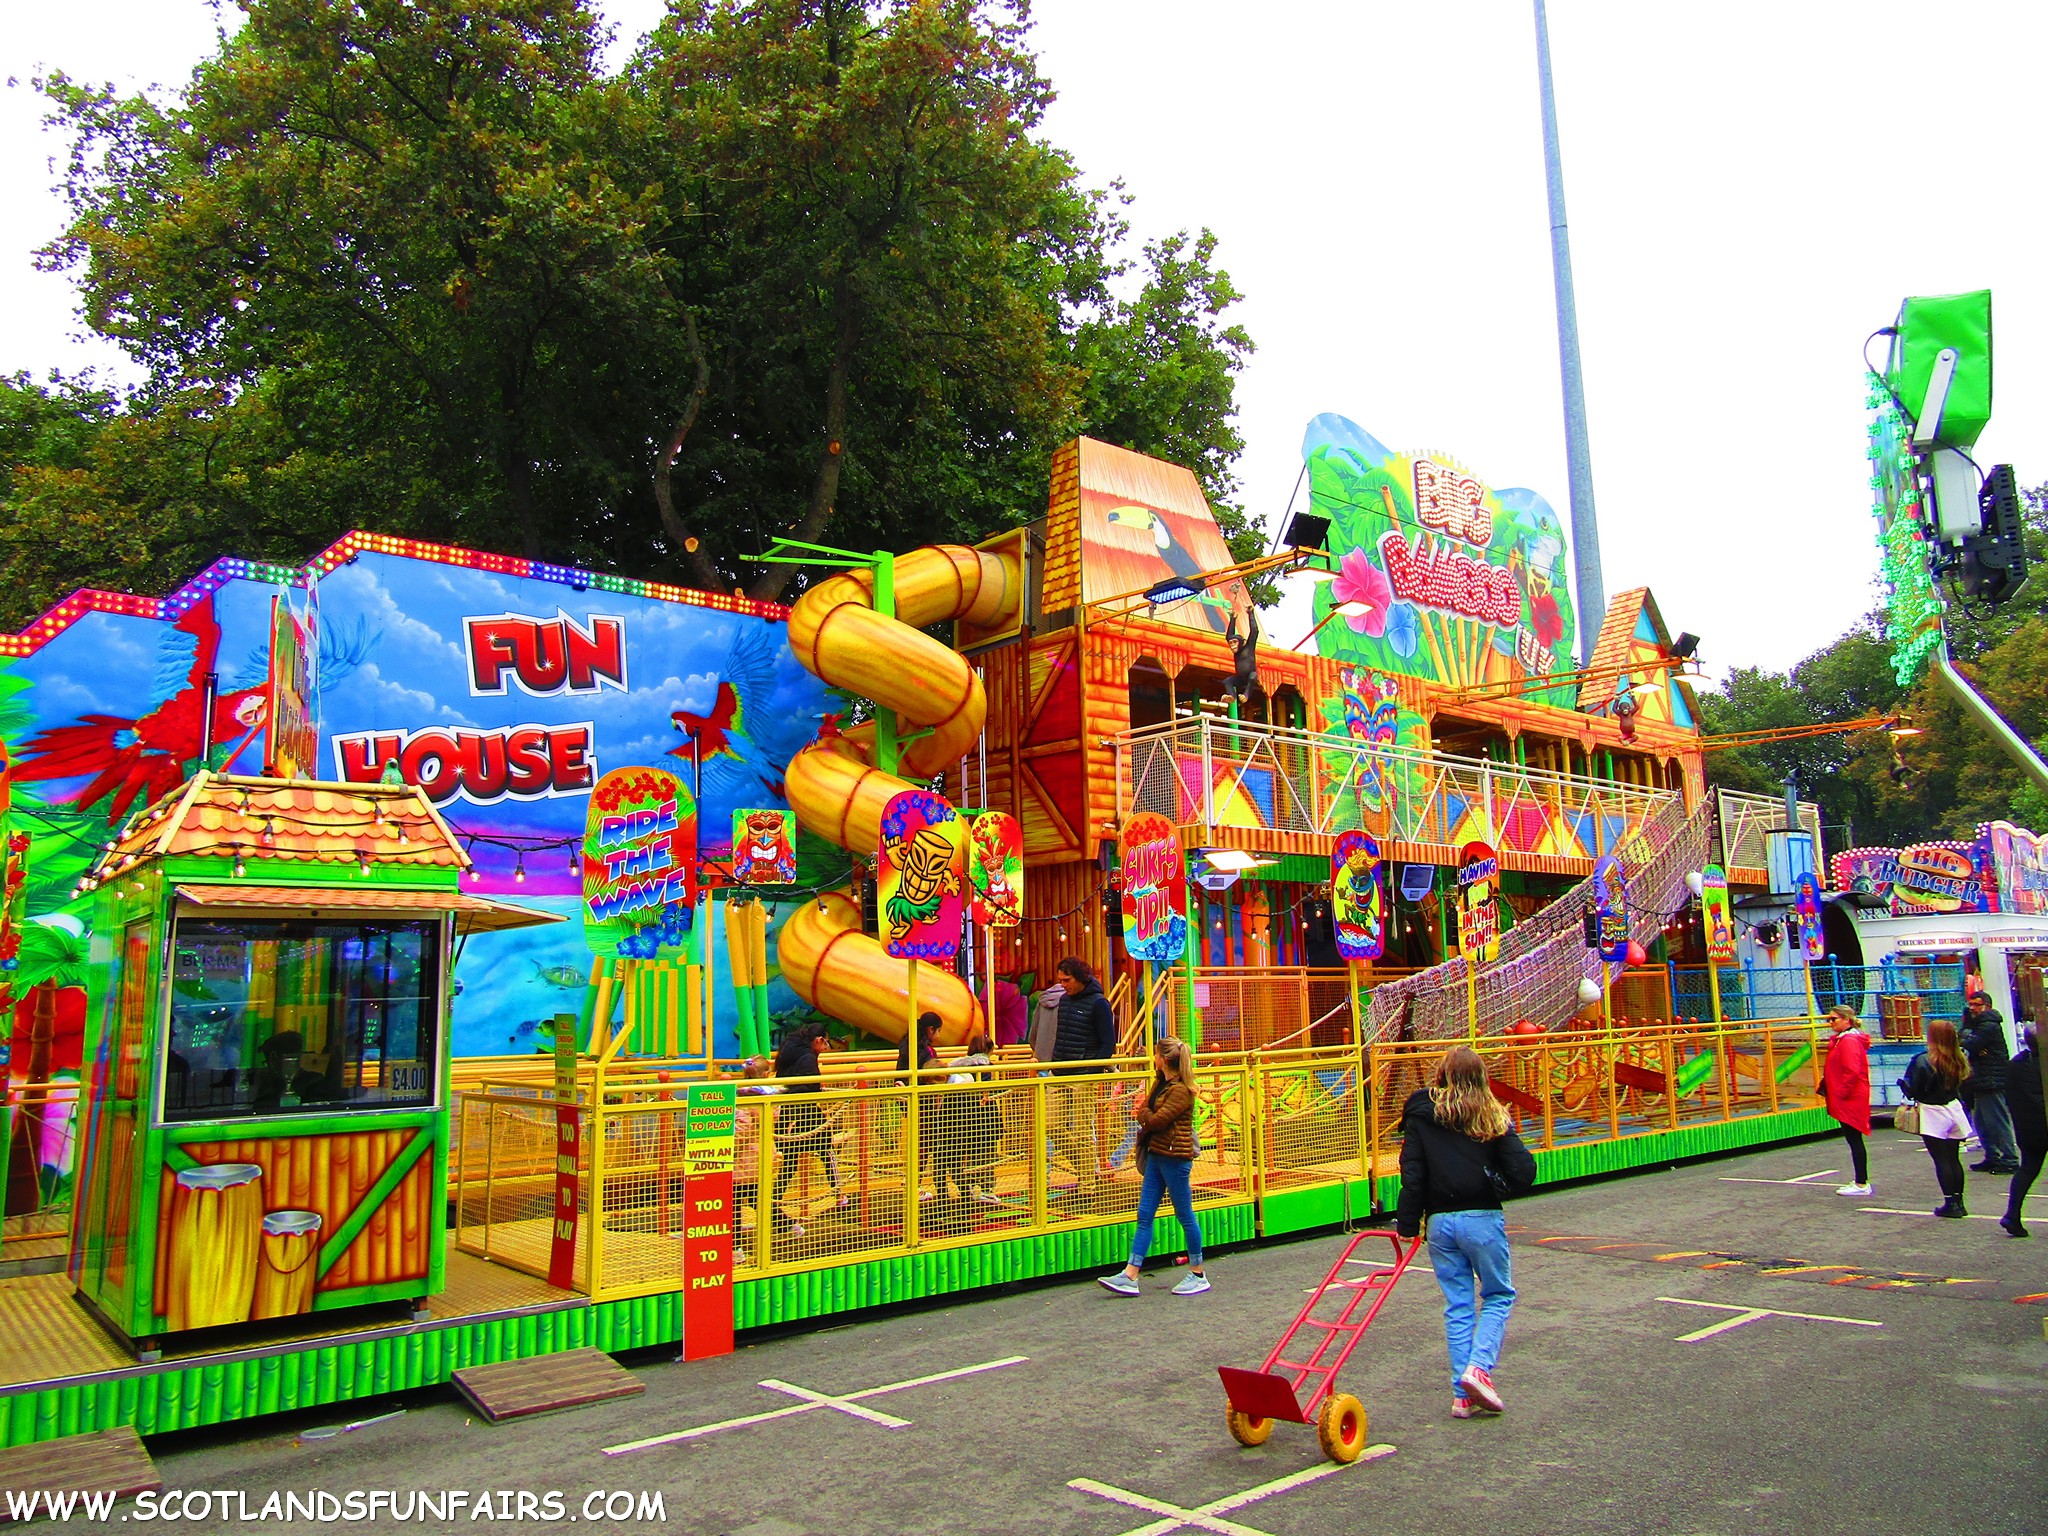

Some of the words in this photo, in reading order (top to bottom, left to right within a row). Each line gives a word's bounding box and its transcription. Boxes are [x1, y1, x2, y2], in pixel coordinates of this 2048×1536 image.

[1414, 460, 1493, 544] BIG
[468, 614, 626, 692] FUN
[339, 726, 594, 802] HOUSE
[600, 798, 679, 848] RIDE
[603, 834, 673, 883] THE
[1124, 834, 1179, 893] SURFS
[1912, 849, 1959, 873] BIG
[1459, 857, 1497, 885] HAVING
[1880, 859, 1981, 904] BURGER
[588, 866, 686, 923] WAVE
[1136, 886, 1170, 942] UP!!
[1462, 910, 1475, 931] IN
[1475, 900, 1495, 925] THE
[1898, 904, 1936, 915] YORK
[1465, 923, 1493, 953] SUN!!
[1897, 938, 1936, 946] CHICKEN
[1938, 937, 1974, 945] BURGER
[1981, 936, 2015, 944] CHEESE
[2017, 935, 2035, 943] HOT
[393, 1067, 427, 1091] £4.00
[700, 1092, 725, 1101] TALL
[690, 1106, 733, 1117] ENOUGH
[561, 1122, 575, 1143] TOO
[690, 1122, 704, 1131] TO
[707, 1120, 731, 1130] PLAY
[689, 1149, 715, 1159] WITH
[717, 1147, 732, 1157] AN
[693, 1161, 726, 1172] ADULT
[562, 1187, 571, 1207] TO
[695, 1199, 723, 1212] TOO
[556, 1219, 574, 1241] PLAY
[687, 1223, 731, 1239] SMALL
[700, 1250, 718, 1263] TO
[692, 1274, 726, 1290] PLAY
